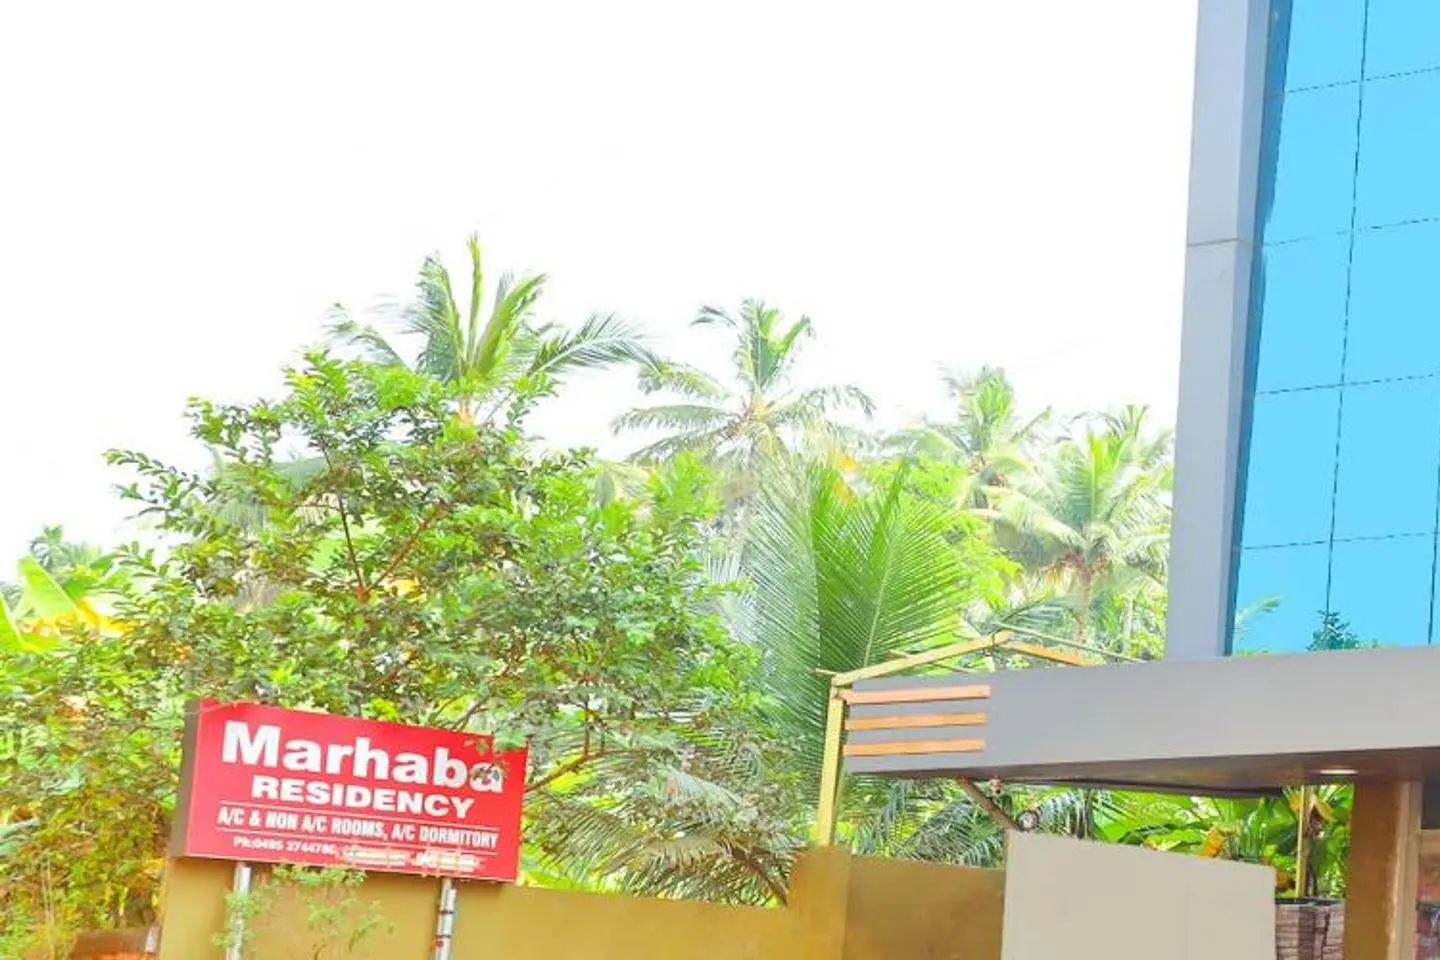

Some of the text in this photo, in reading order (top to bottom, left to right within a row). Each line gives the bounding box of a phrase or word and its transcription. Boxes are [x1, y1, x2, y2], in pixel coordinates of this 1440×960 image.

[222, 720, 504, 793] Marhaba
[251, 774, 475, 819] RESIDENCY
[217, 806, 498, 848] A/C & NON A/C ROOMS, A/C DORMITORY
